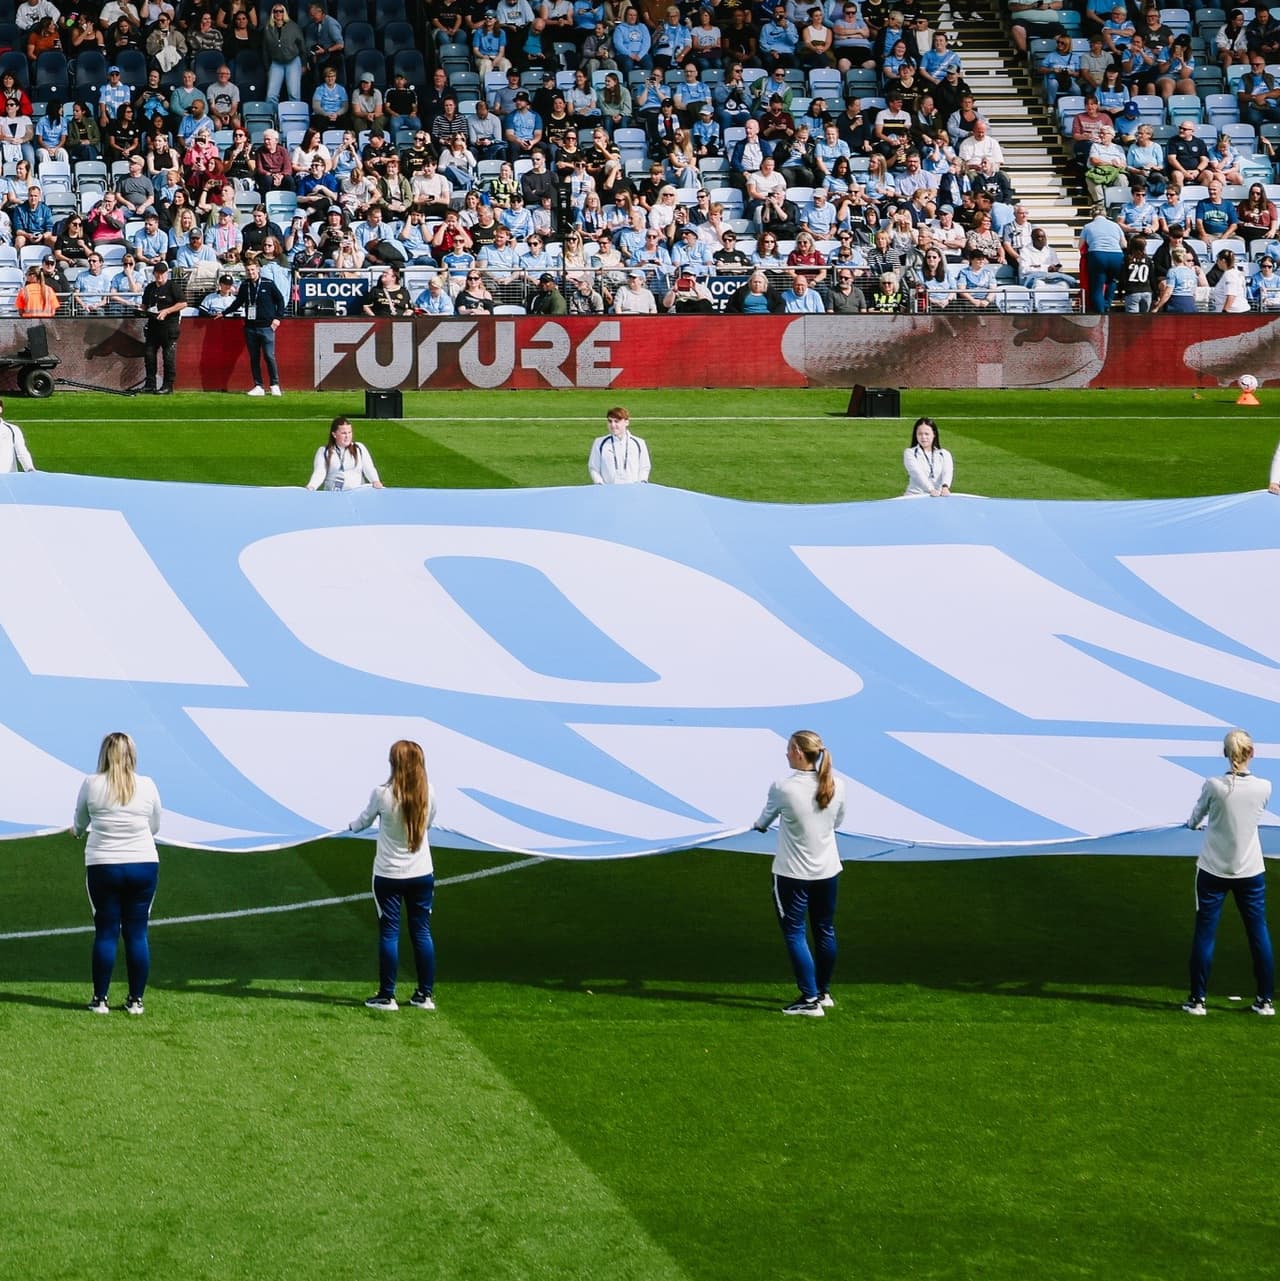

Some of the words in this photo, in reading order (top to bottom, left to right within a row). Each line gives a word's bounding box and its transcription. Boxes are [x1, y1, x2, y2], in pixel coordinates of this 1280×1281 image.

[1128, 264, 1149, 282] 20
[305, 283, 364, 297] BLOCK
[314, 321, 623, 388] FUTURE
